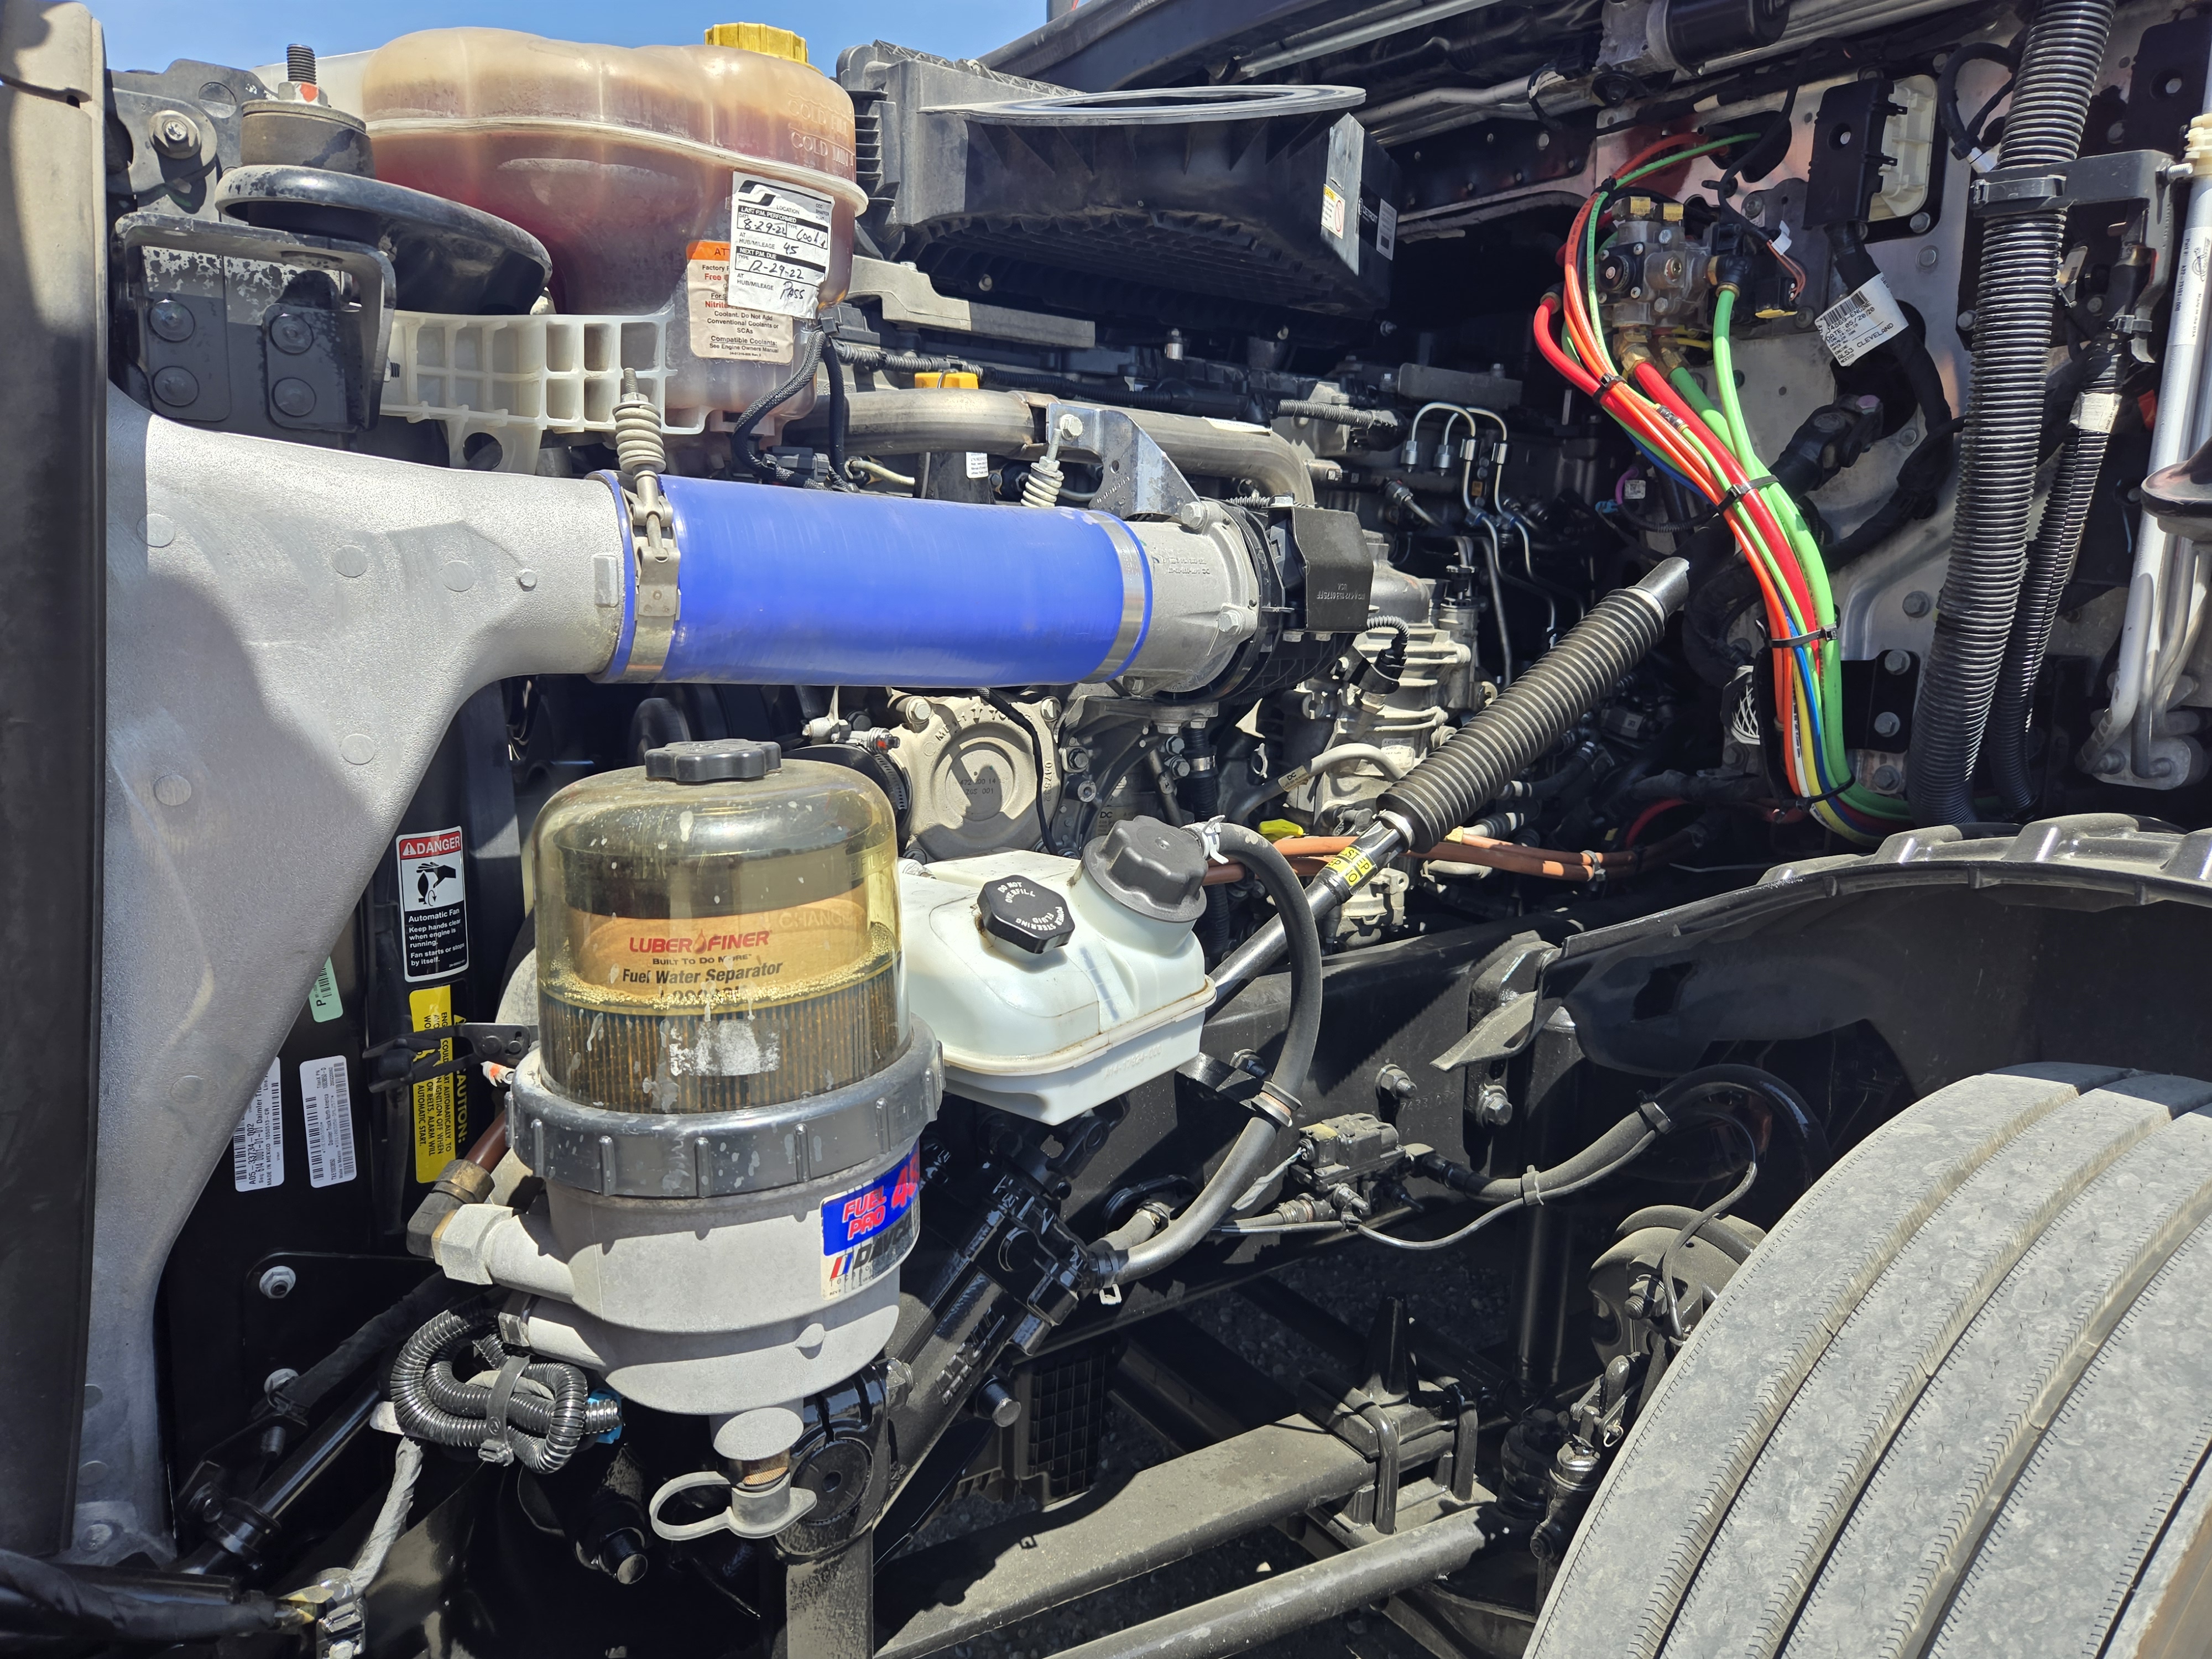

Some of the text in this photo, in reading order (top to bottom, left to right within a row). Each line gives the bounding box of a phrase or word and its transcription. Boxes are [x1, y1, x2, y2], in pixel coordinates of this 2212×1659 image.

[791, 132, 828, 156] COLD
[776, 205, 800, 215] LOCATION
[767, 212, 797, 223] PERFORMED
[739, 238, 775, 249] HUB/MILEAGE
[737, 279, 774, 291] HUB/MILEAGE
[711, 336, 778, 346] Compatible Coolants:
[1856, 322, 1893, 348] CLEVELAND
[1287, 772, 1297, 781] DC
[416, 836, 461, 854] DANGER
[1345, 849, 1370, 872] STEP
[998, 885, 1008, 893] DO
[1005, 888, 1036, 904] OVERFILL
[409, 911, 448, 923] Automatic
[1015, 906, 1065, 931] POWER STEERING
[1032, 912, 1055, 924] FLUID
[428, 922, 448, 931] hands
[429, 930, 450, 938] engine
[410, 940, 438, 948] running.
[629, 930, 770, 953] LUBER FINER
[623, 962, 783, 984] Fuel Water Separator
[426, 1082, 433, 1092] OR
[456, 1070, 467, 1144] AUTION:
[445, 1142, 452, 1152] TO
[842, 1185, 887, 1223] FUEL
[847, 1205, 886, 1241] PRO
